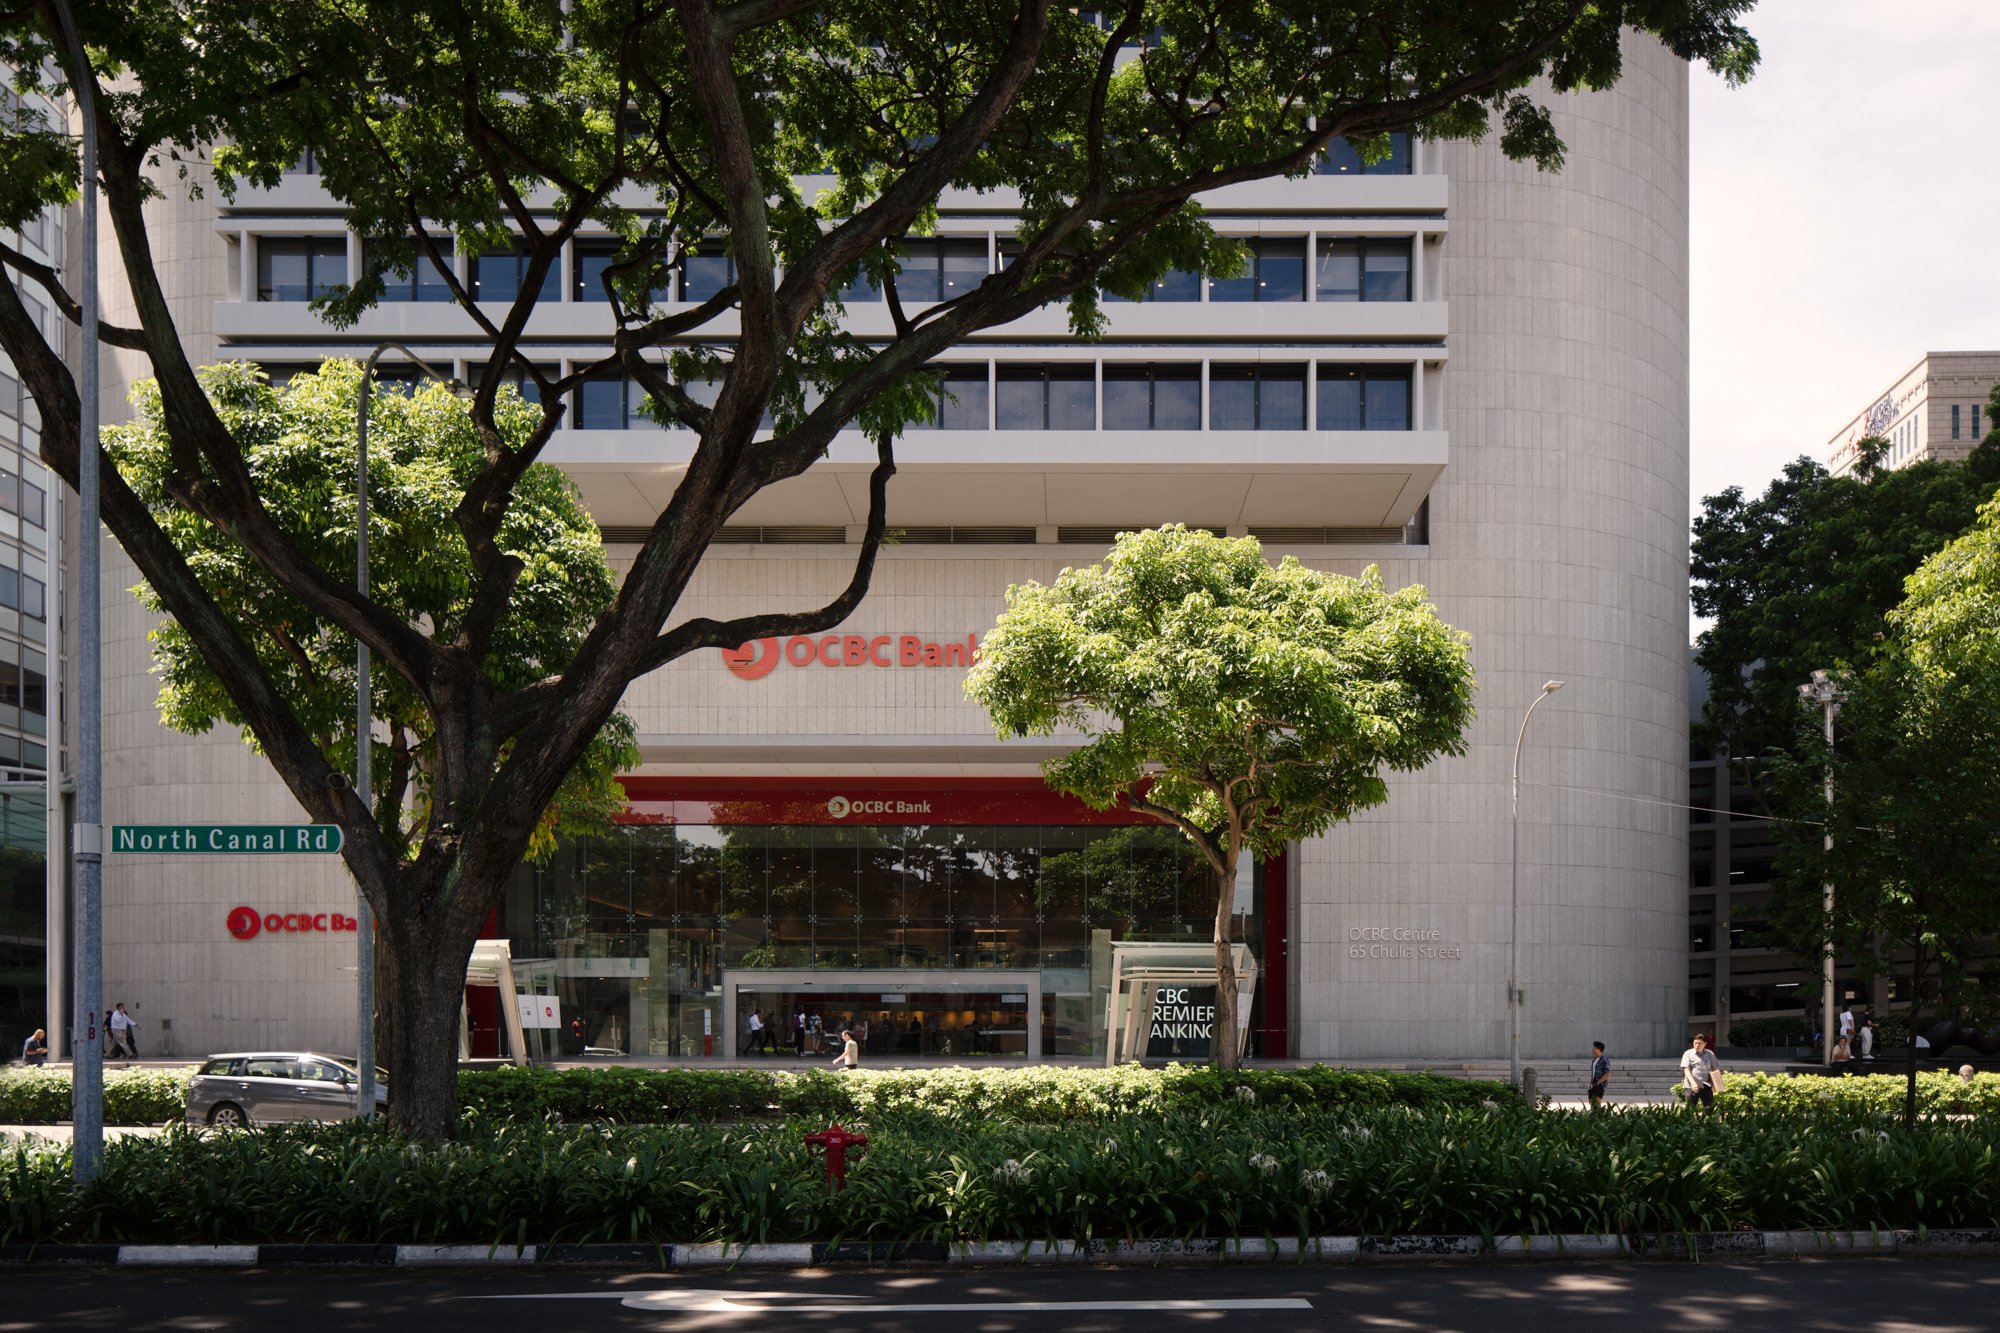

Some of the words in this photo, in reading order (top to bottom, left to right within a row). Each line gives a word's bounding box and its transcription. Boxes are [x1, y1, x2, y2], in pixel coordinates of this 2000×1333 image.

[785, 635, 892, 667] OCBC
[851, 800, 894, 814] OCBC
[896, 799, 932, 814] Bank
[120, 828, 197, 850] North
[209, 828, 285, 850] Canal
[297, 828, 328, 850] Rd
[263, 913, 328, 932] OCBC
[1349, 927, 1391, 941] OCBC
[1393, 927, 1441, 941] Centre
[1349, 945, 1366, 959] 65
[1369, 944, 1414, 959] Chulia
[1418, 944, 1462, 959] Street
[1155, 988, 1189, 1004] CBC
[1151, 1005, 1215, 1021] REMIER
[1149, 1023, 1213, 1039] ANKIN
